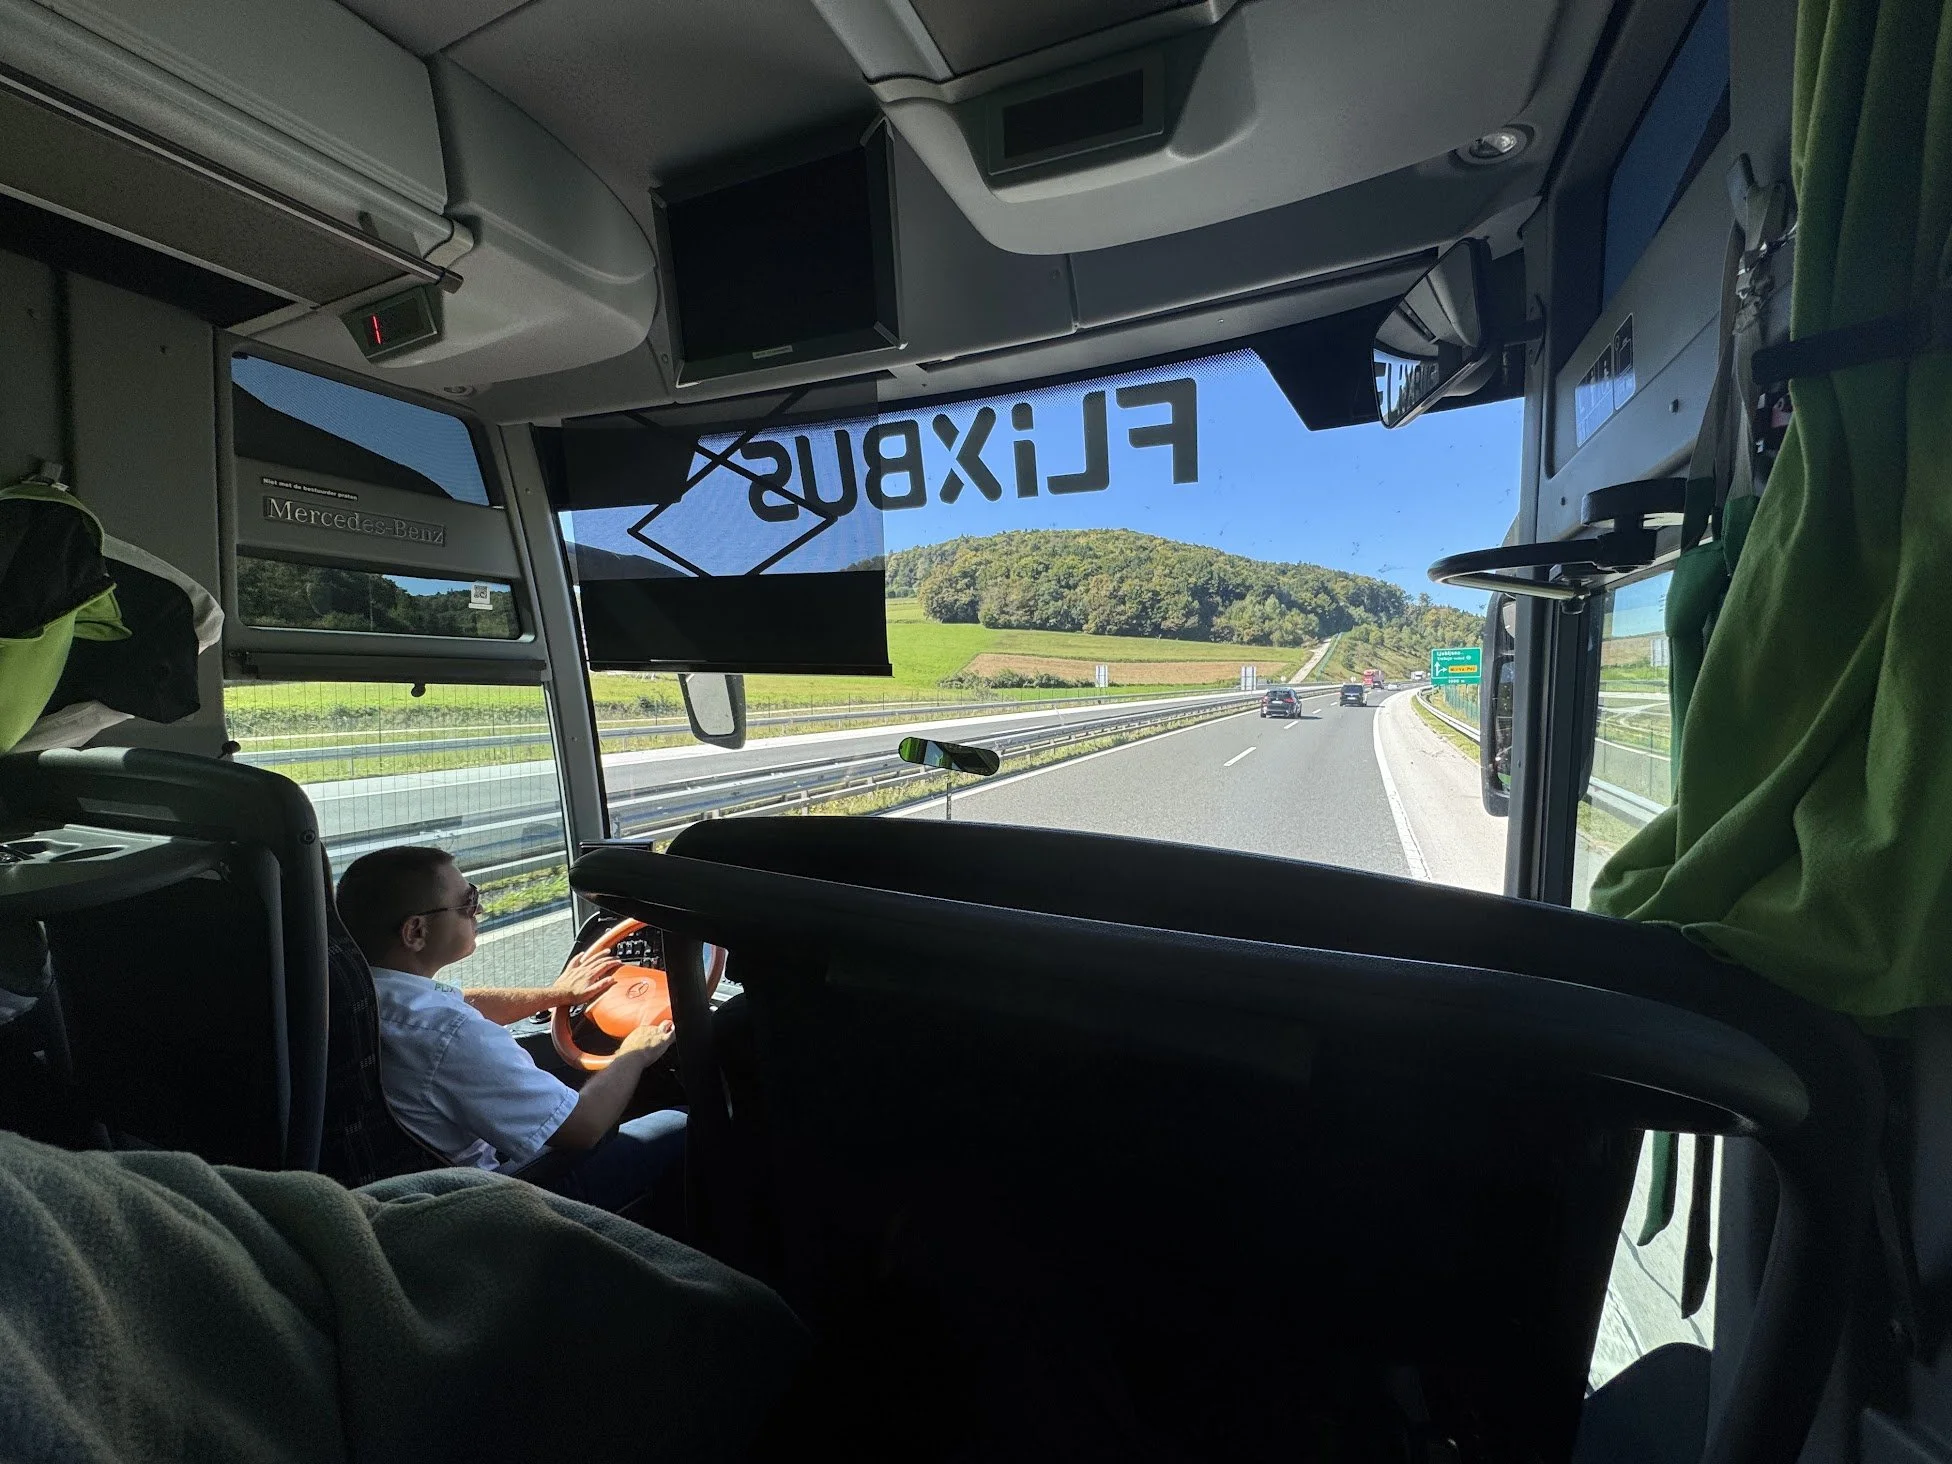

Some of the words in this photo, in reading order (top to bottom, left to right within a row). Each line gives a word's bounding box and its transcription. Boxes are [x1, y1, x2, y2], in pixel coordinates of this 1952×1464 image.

[263, 478, 278, 486] Niet
[303, 485, 337, 496] bestuurder
[268, 498, 444, 544] Mercedes-Benz
